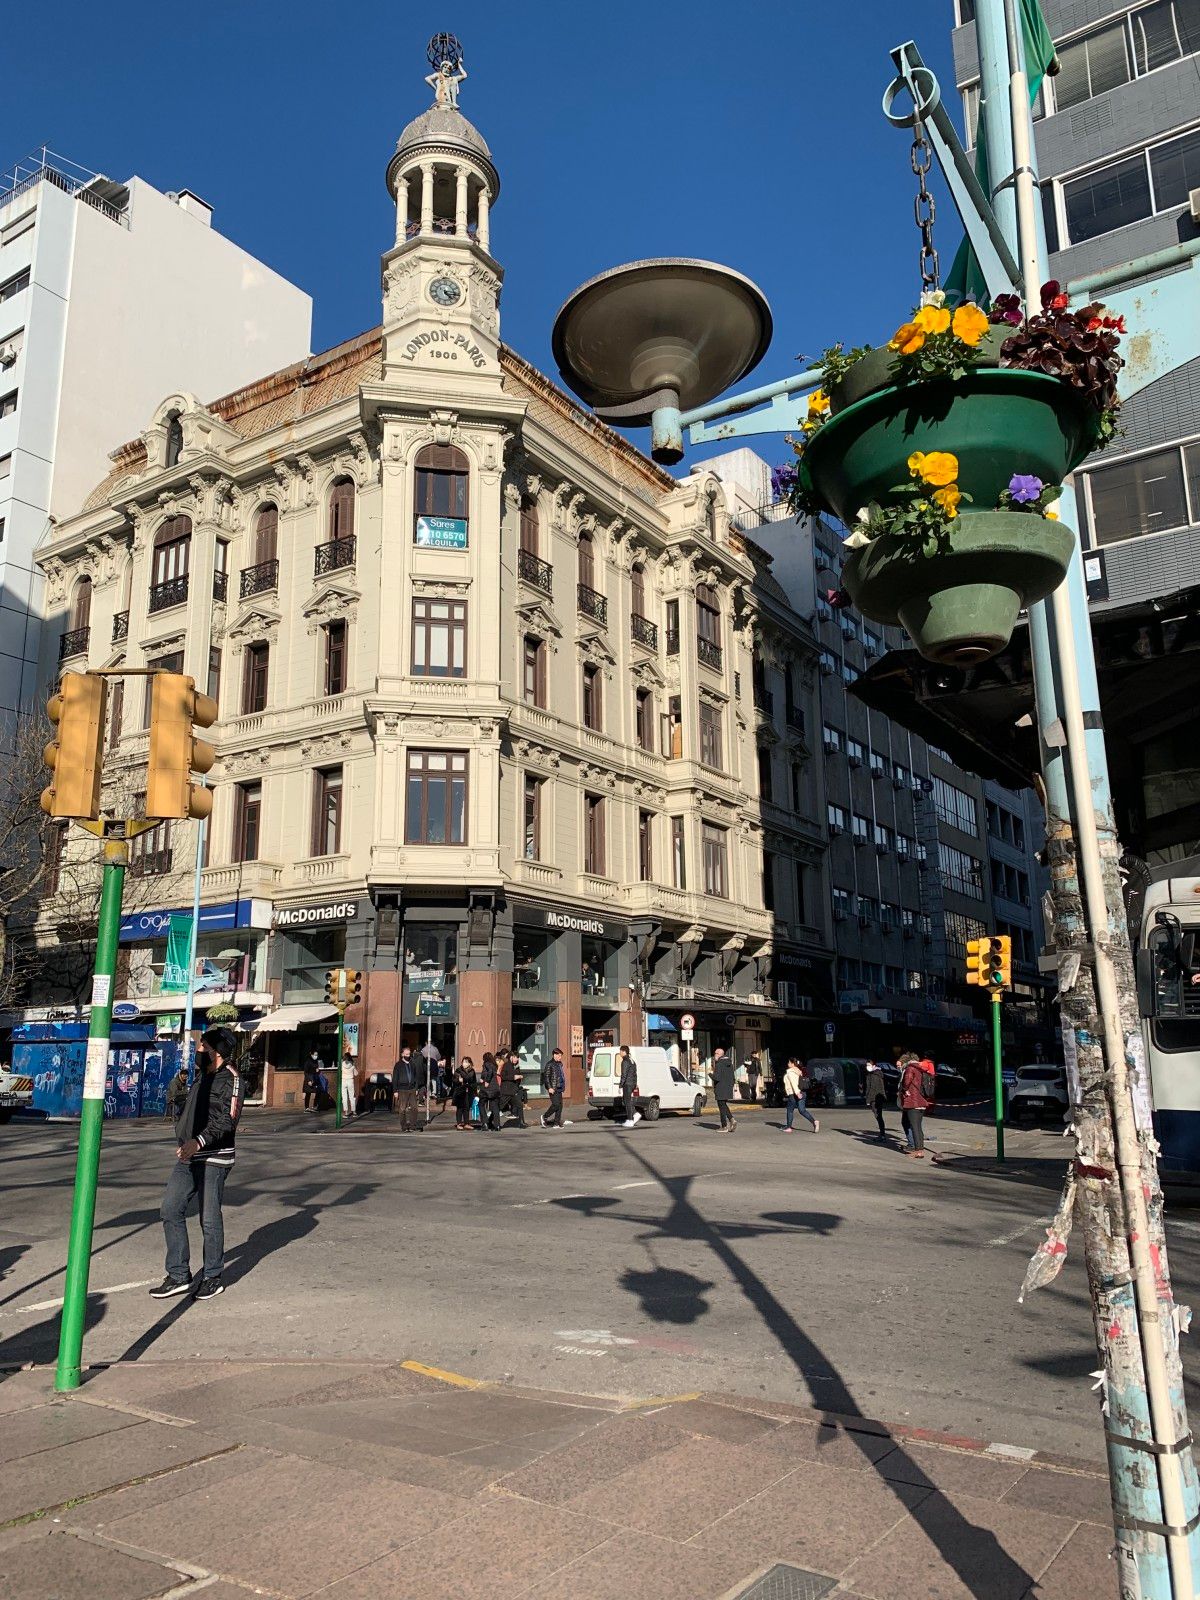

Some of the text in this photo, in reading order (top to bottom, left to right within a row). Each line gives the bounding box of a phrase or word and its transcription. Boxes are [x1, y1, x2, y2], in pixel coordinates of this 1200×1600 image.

[401, 329, 486, 368] LONDON-PARIS
[430, 519, 455, 528] Sures
[443, 531, 464, 541] 6570
[278, 902, 356, 925] McDonald's
[547, 911, 604, 934] McDonald's
